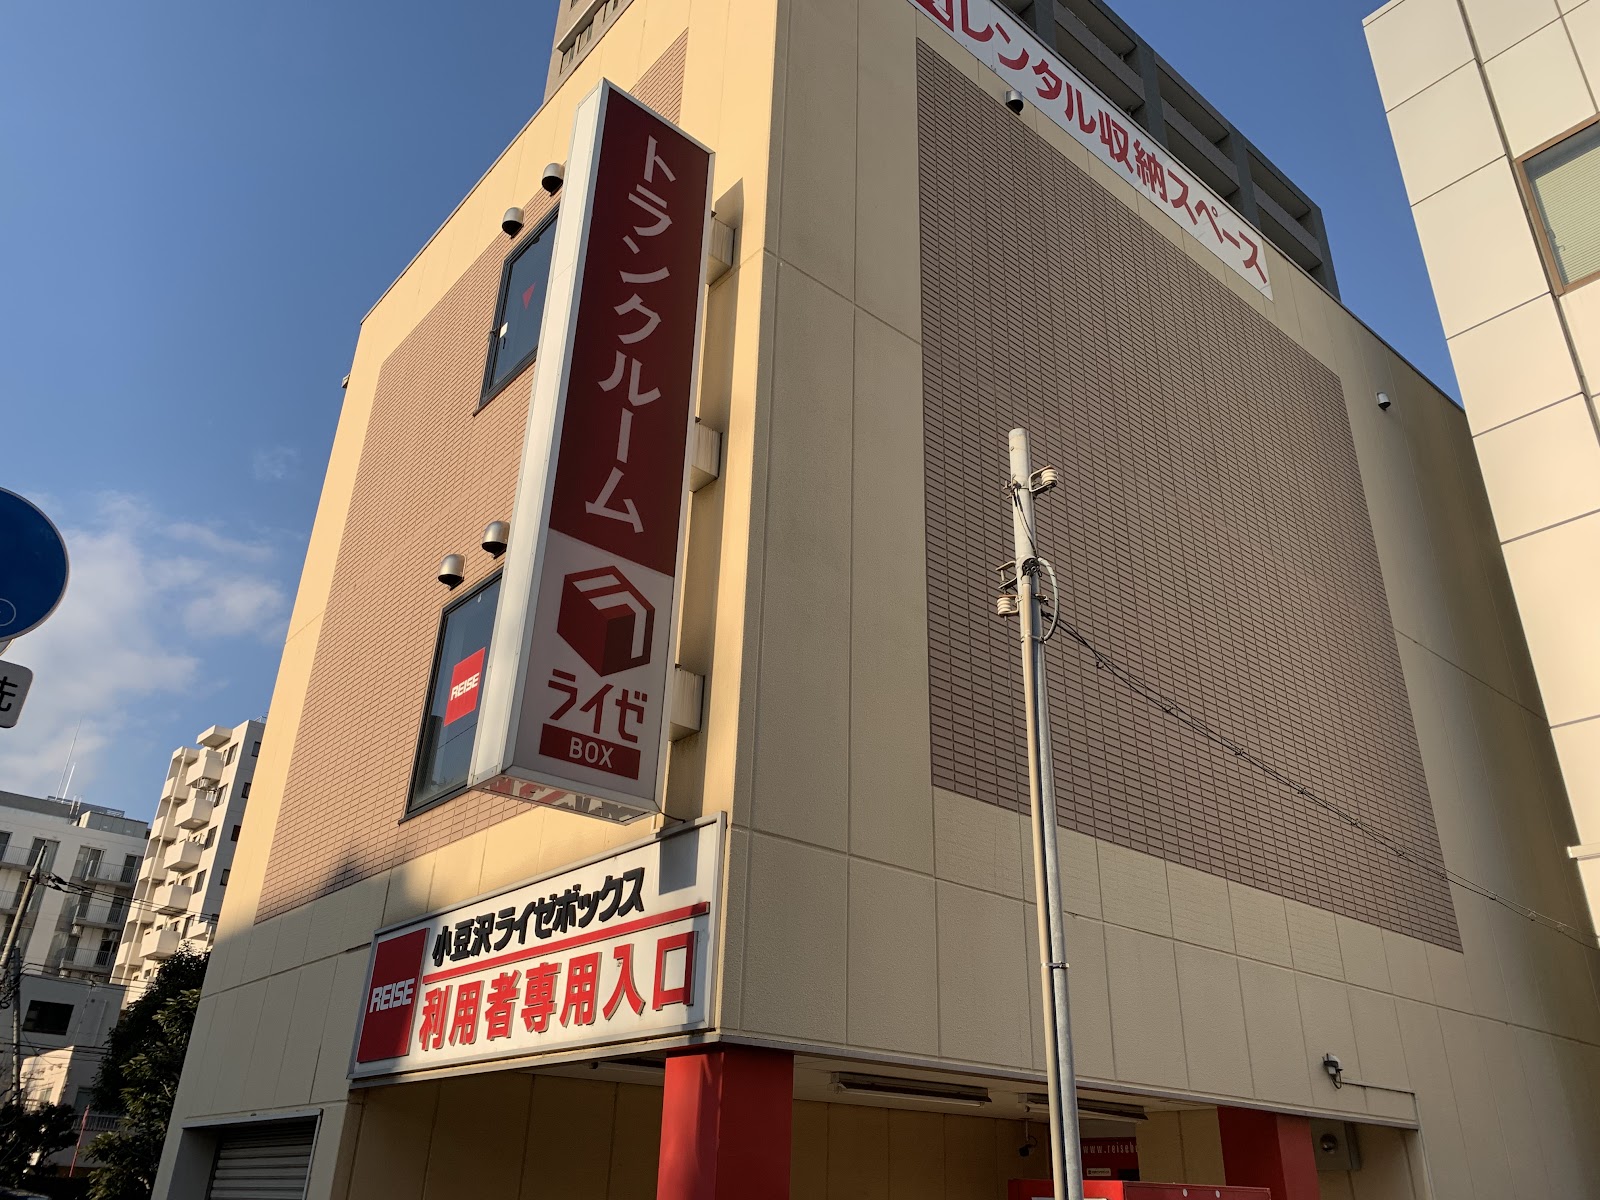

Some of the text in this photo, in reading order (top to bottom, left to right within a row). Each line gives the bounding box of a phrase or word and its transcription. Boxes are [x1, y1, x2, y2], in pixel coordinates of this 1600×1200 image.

[585, 135, 676, 533] トランクルーム
[450, 672, 480, 701] REISE
[548, 668, 648, 743] ライゼ
[569, 737, 614, 768] BOX
[432, 867, 645, 966] 小豆沢ライゼボックス
[368, 978, 415, 1013] REISE
[418, 930, 698, 1051] 利用者専用入口
